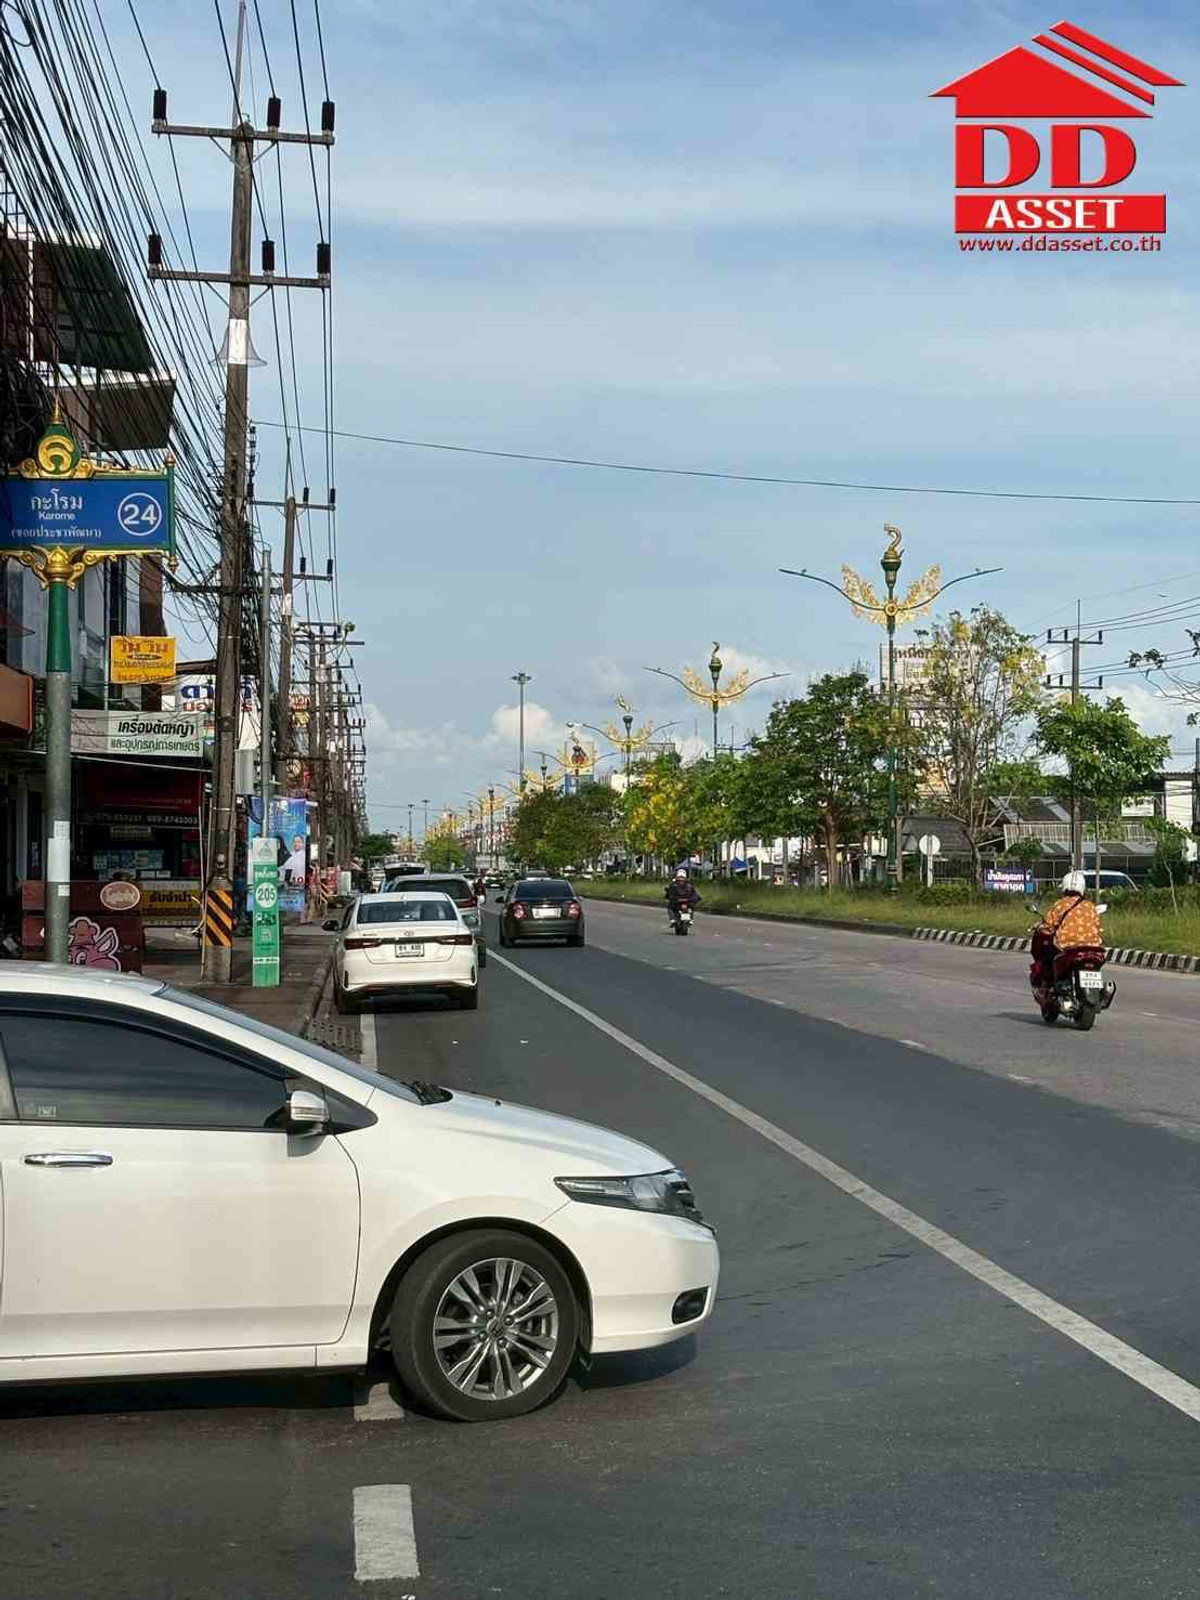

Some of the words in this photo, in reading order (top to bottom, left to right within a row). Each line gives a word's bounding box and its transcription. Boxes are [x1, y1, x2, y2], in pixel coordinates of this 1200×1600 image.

[31, 488, 82, 510] กะโรม
[38, 511, 76, 520] Karome
[123, 504, 157, 525] 24
[118, 714, 195, 737] เครื่องตัดหญ้า
[257, 888, 277, 901] 205
